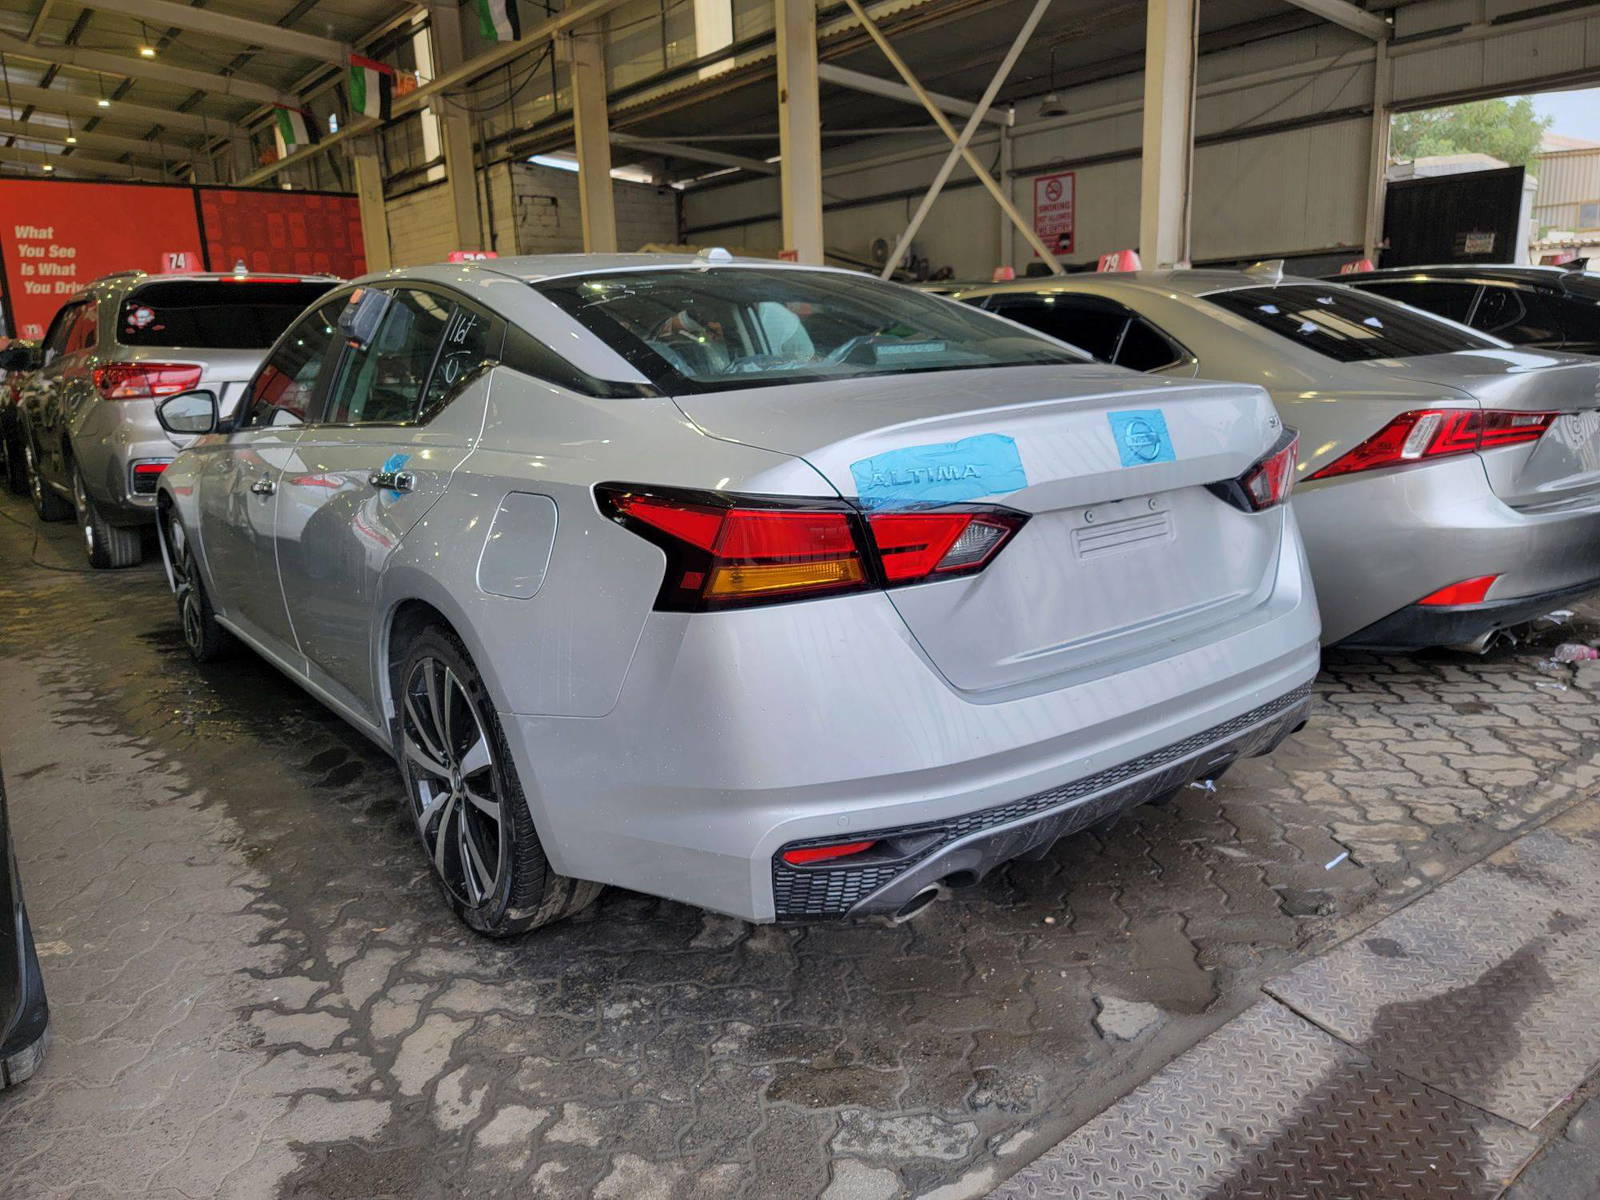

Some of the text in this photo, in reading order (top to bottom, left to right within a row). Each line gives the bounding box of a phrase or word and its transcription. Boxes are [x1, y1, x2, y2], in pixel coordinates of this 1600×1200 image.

[15, 226, 54, 239] What
[18, 245, 76, 258] You See
[169, 253, 185, 269] 74
[21, 263, 76, 276] Is What
[24, 281, 84, 294] You Driv
[868, 464, 982, 490] ALTIMA
